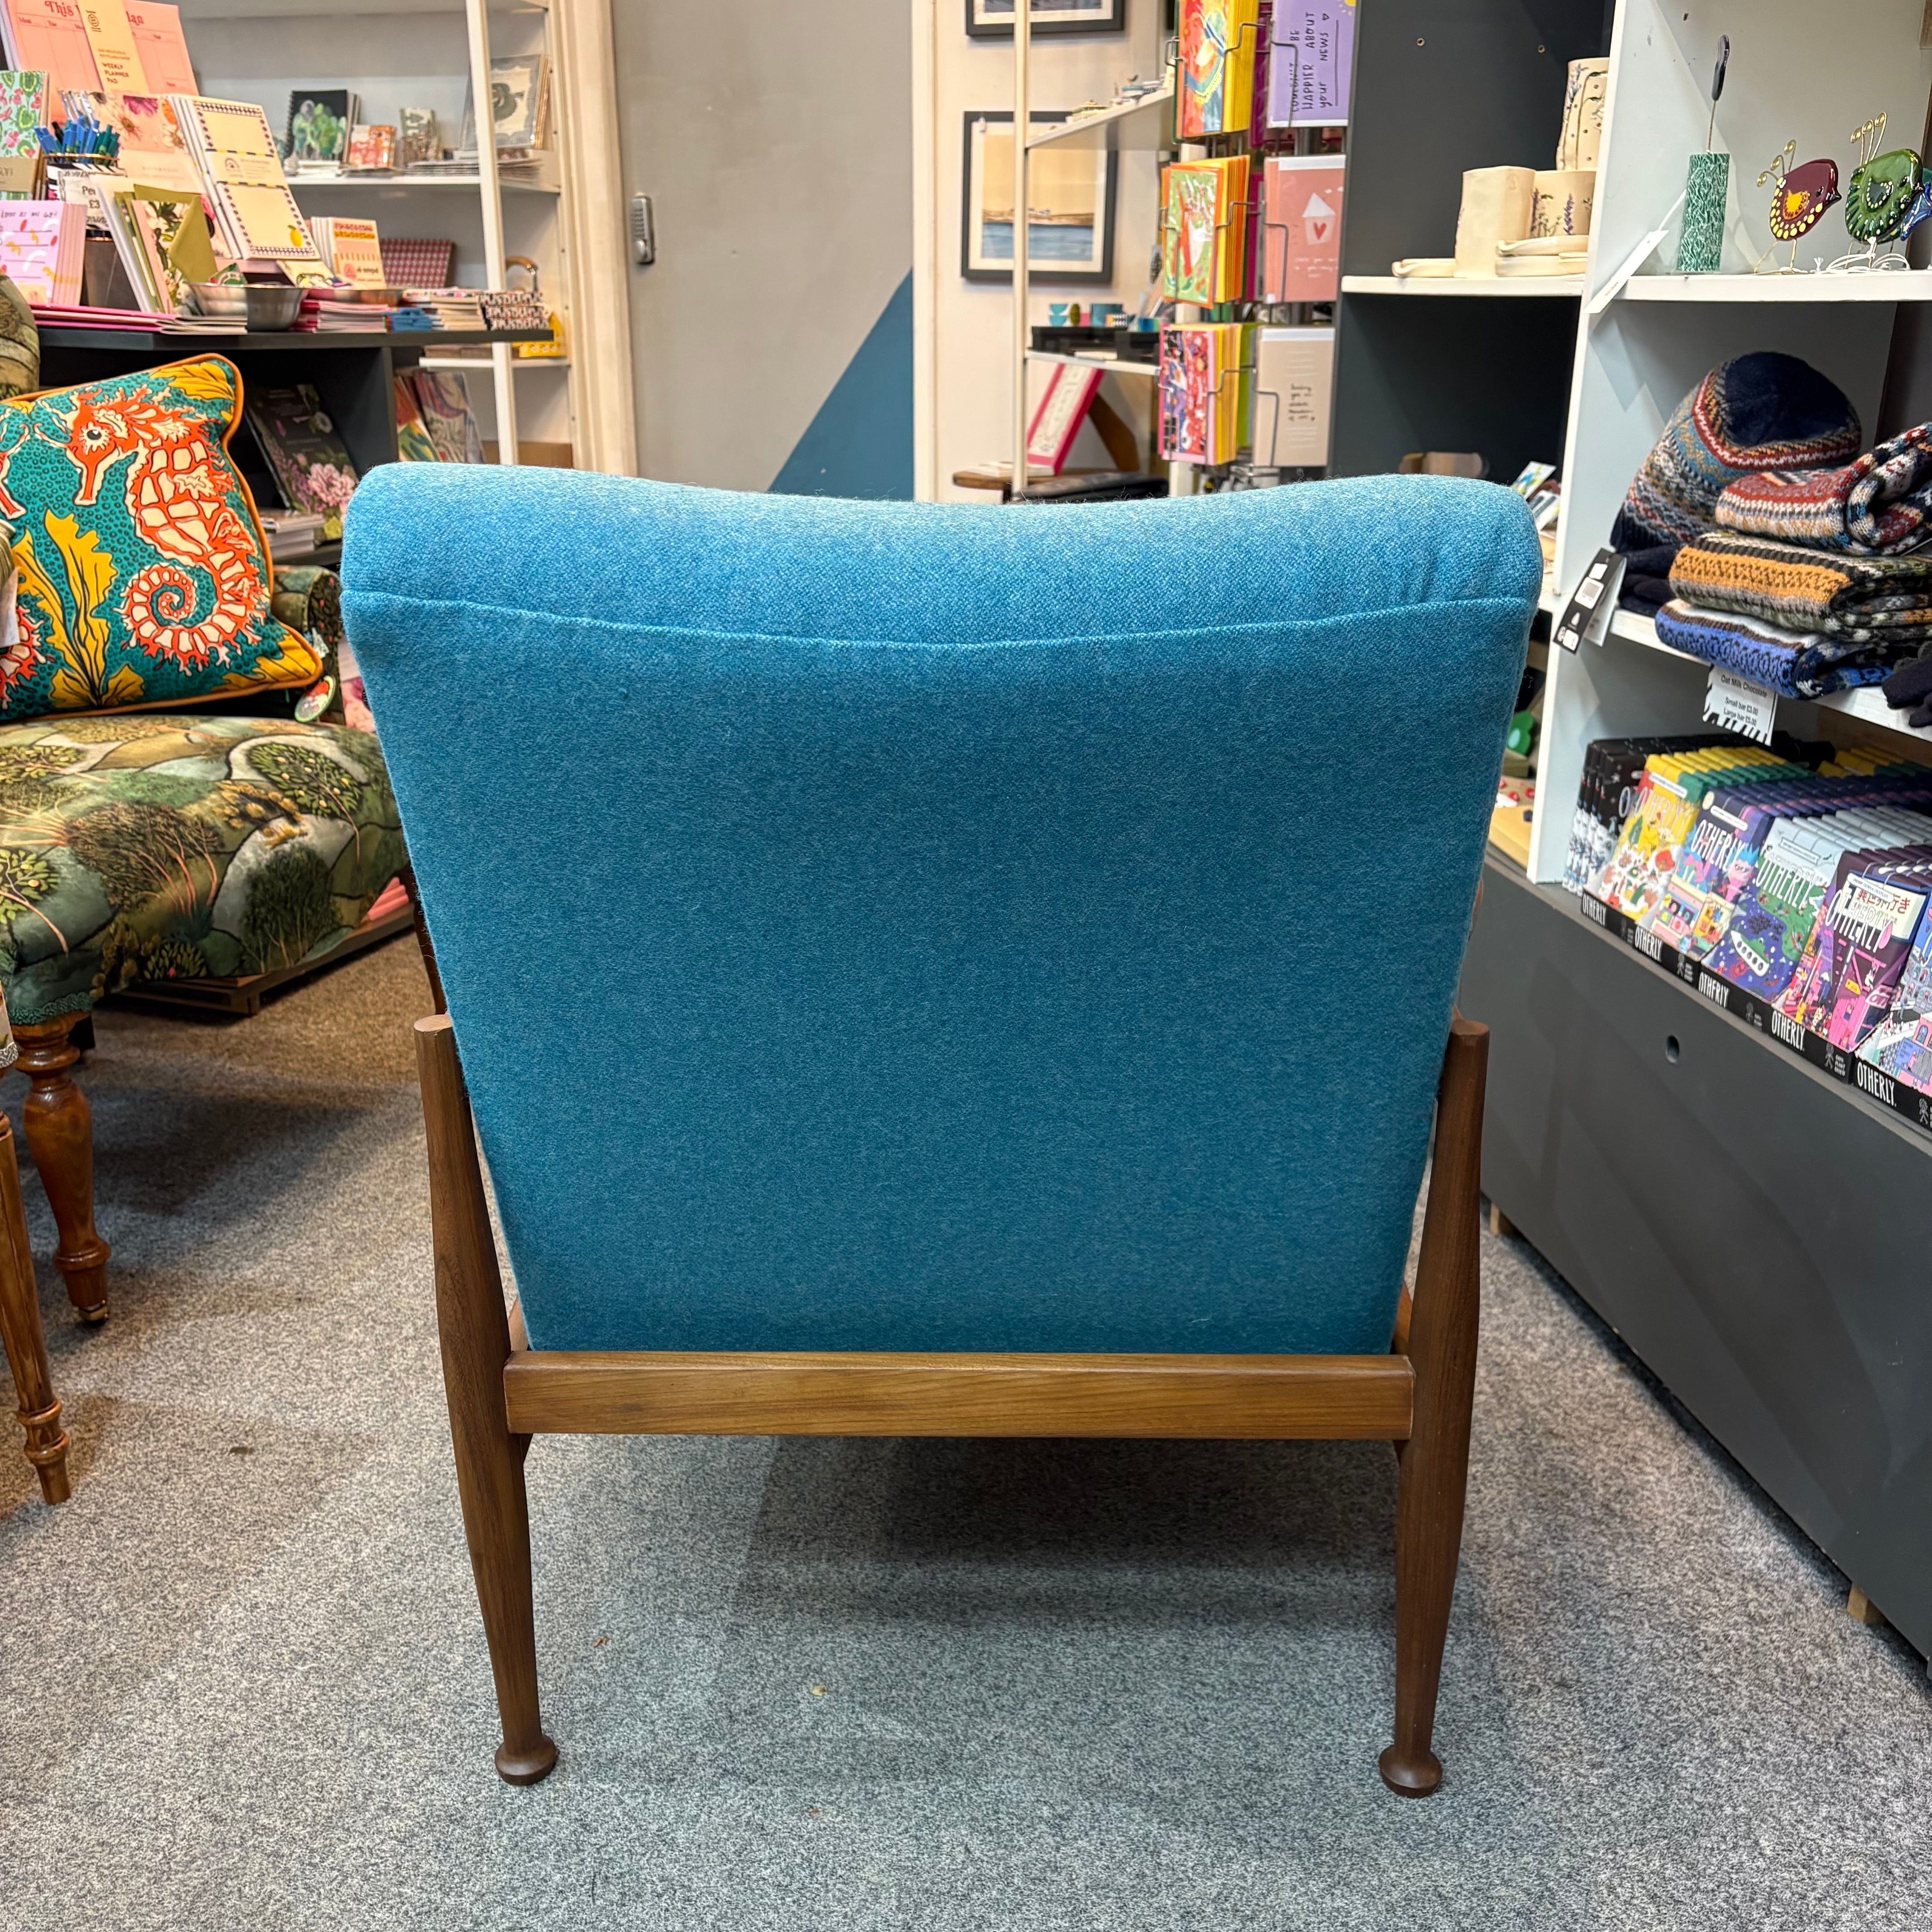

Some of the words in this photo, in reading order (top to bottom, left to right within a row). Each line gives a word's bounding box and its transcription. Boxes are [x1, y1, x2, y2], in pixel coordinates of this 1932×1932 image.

[45, 1, 74, 17] This
[126, 11, 144, 26] lan
[1305, 12, 1315, 48] ABOUT
[1290, 30, 1300, 41] BE
[1320, 32, 1329, 61] NEWS
[1302, 64, 1315, 110] HAPPIER
[1319, 81, 1333, 108] your
[1721, 675, 1730, 685] Oat
[1731, 678, 1742, 689] Milk
[1743, 682, 1767, 698] Chocolate
[1725, 696, 1738, 708] Small
[1724, 707, 1737, 718] Large
[1691, 819, 1746, 873] OTHERLY
[1756, 852, 1817, 910] OTHERLY
[1582, 893, 1606, 926] OTHERLY
[1825, 889, 1893, 953] OTHERLY
[1635, 926, 1662, 962] OTHERLY
[1698, 971, 1729, 1008] OTHERLY
